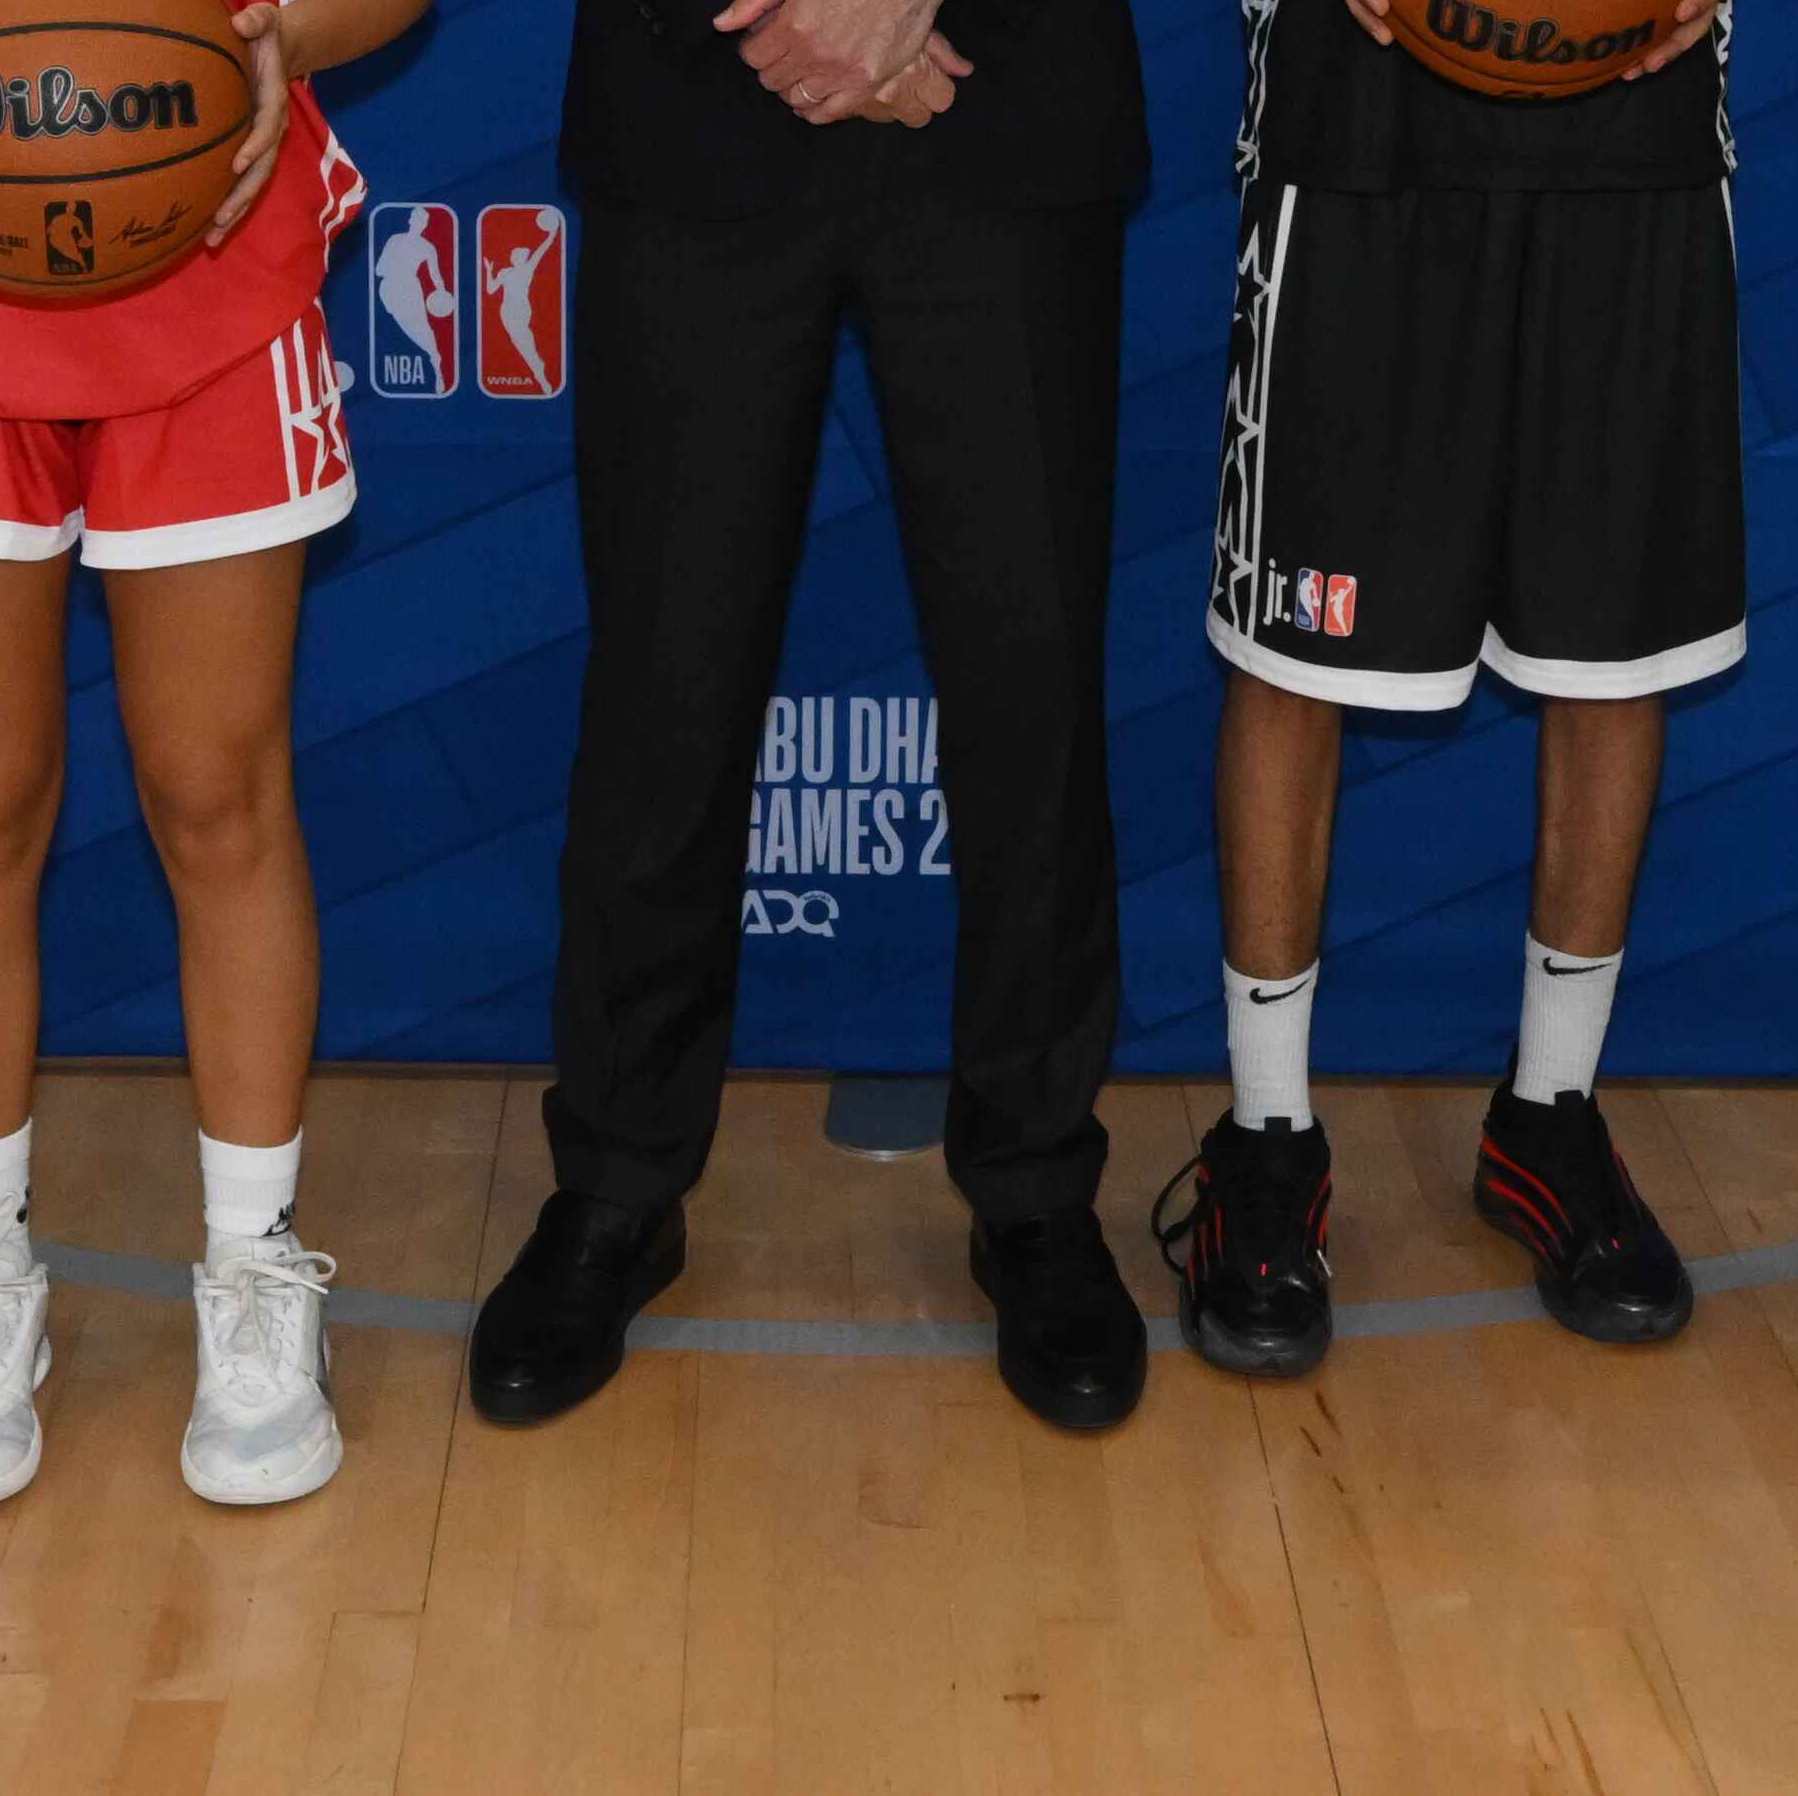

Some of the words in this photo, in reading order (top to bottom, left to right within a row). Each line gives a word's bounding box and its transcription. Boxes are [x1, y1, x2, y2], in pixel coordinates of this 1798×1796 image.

[384, 355, 425, 385] NBA
[486, 376, 533, 386] WNBA
[1263, 558, 1292, 626] jr.
[754, 695, 835, 784] BU
[741, 889, 840, 938] ADQ
